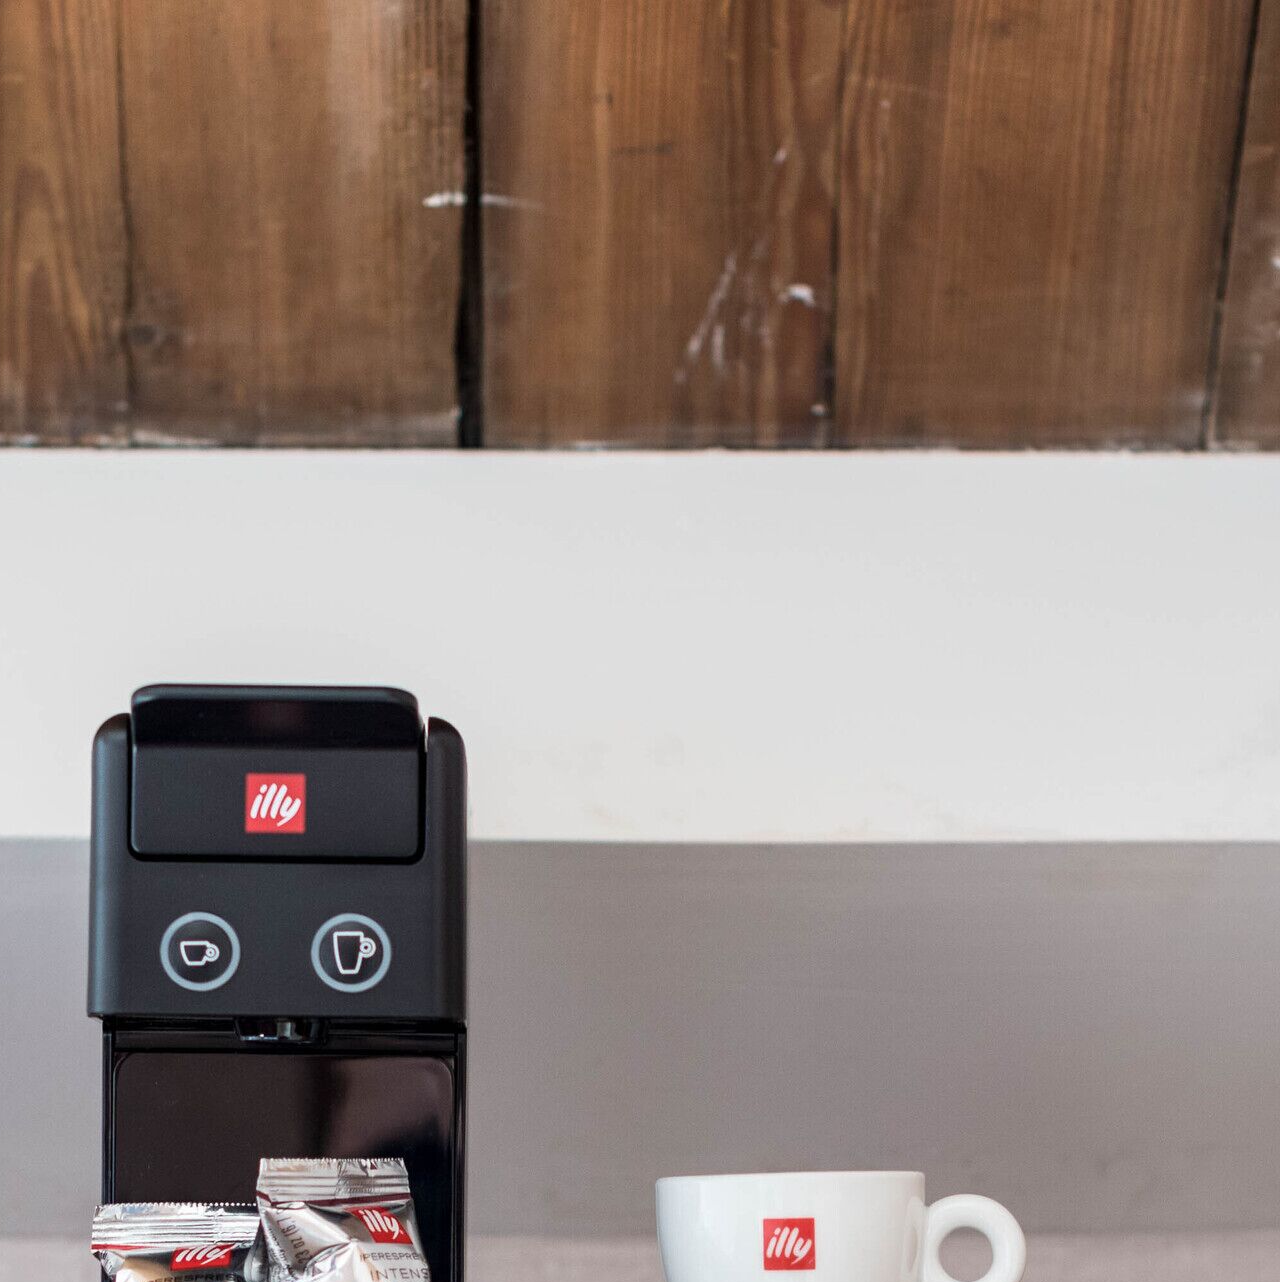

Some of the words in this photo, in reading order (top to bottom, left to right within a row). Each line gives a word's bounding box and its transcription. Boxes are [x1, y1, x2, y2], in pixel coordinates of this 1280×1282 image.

[249, 783, 301, 826] illy
[358, 1209, 400, 1240] illy
[175, 1244, 238, 1265] illy
[359, 1252, 422, 1261] IPERESPRE
[766, 1226, 813, 1265] illy
[370, 1267, 430, 1281] INTENS
